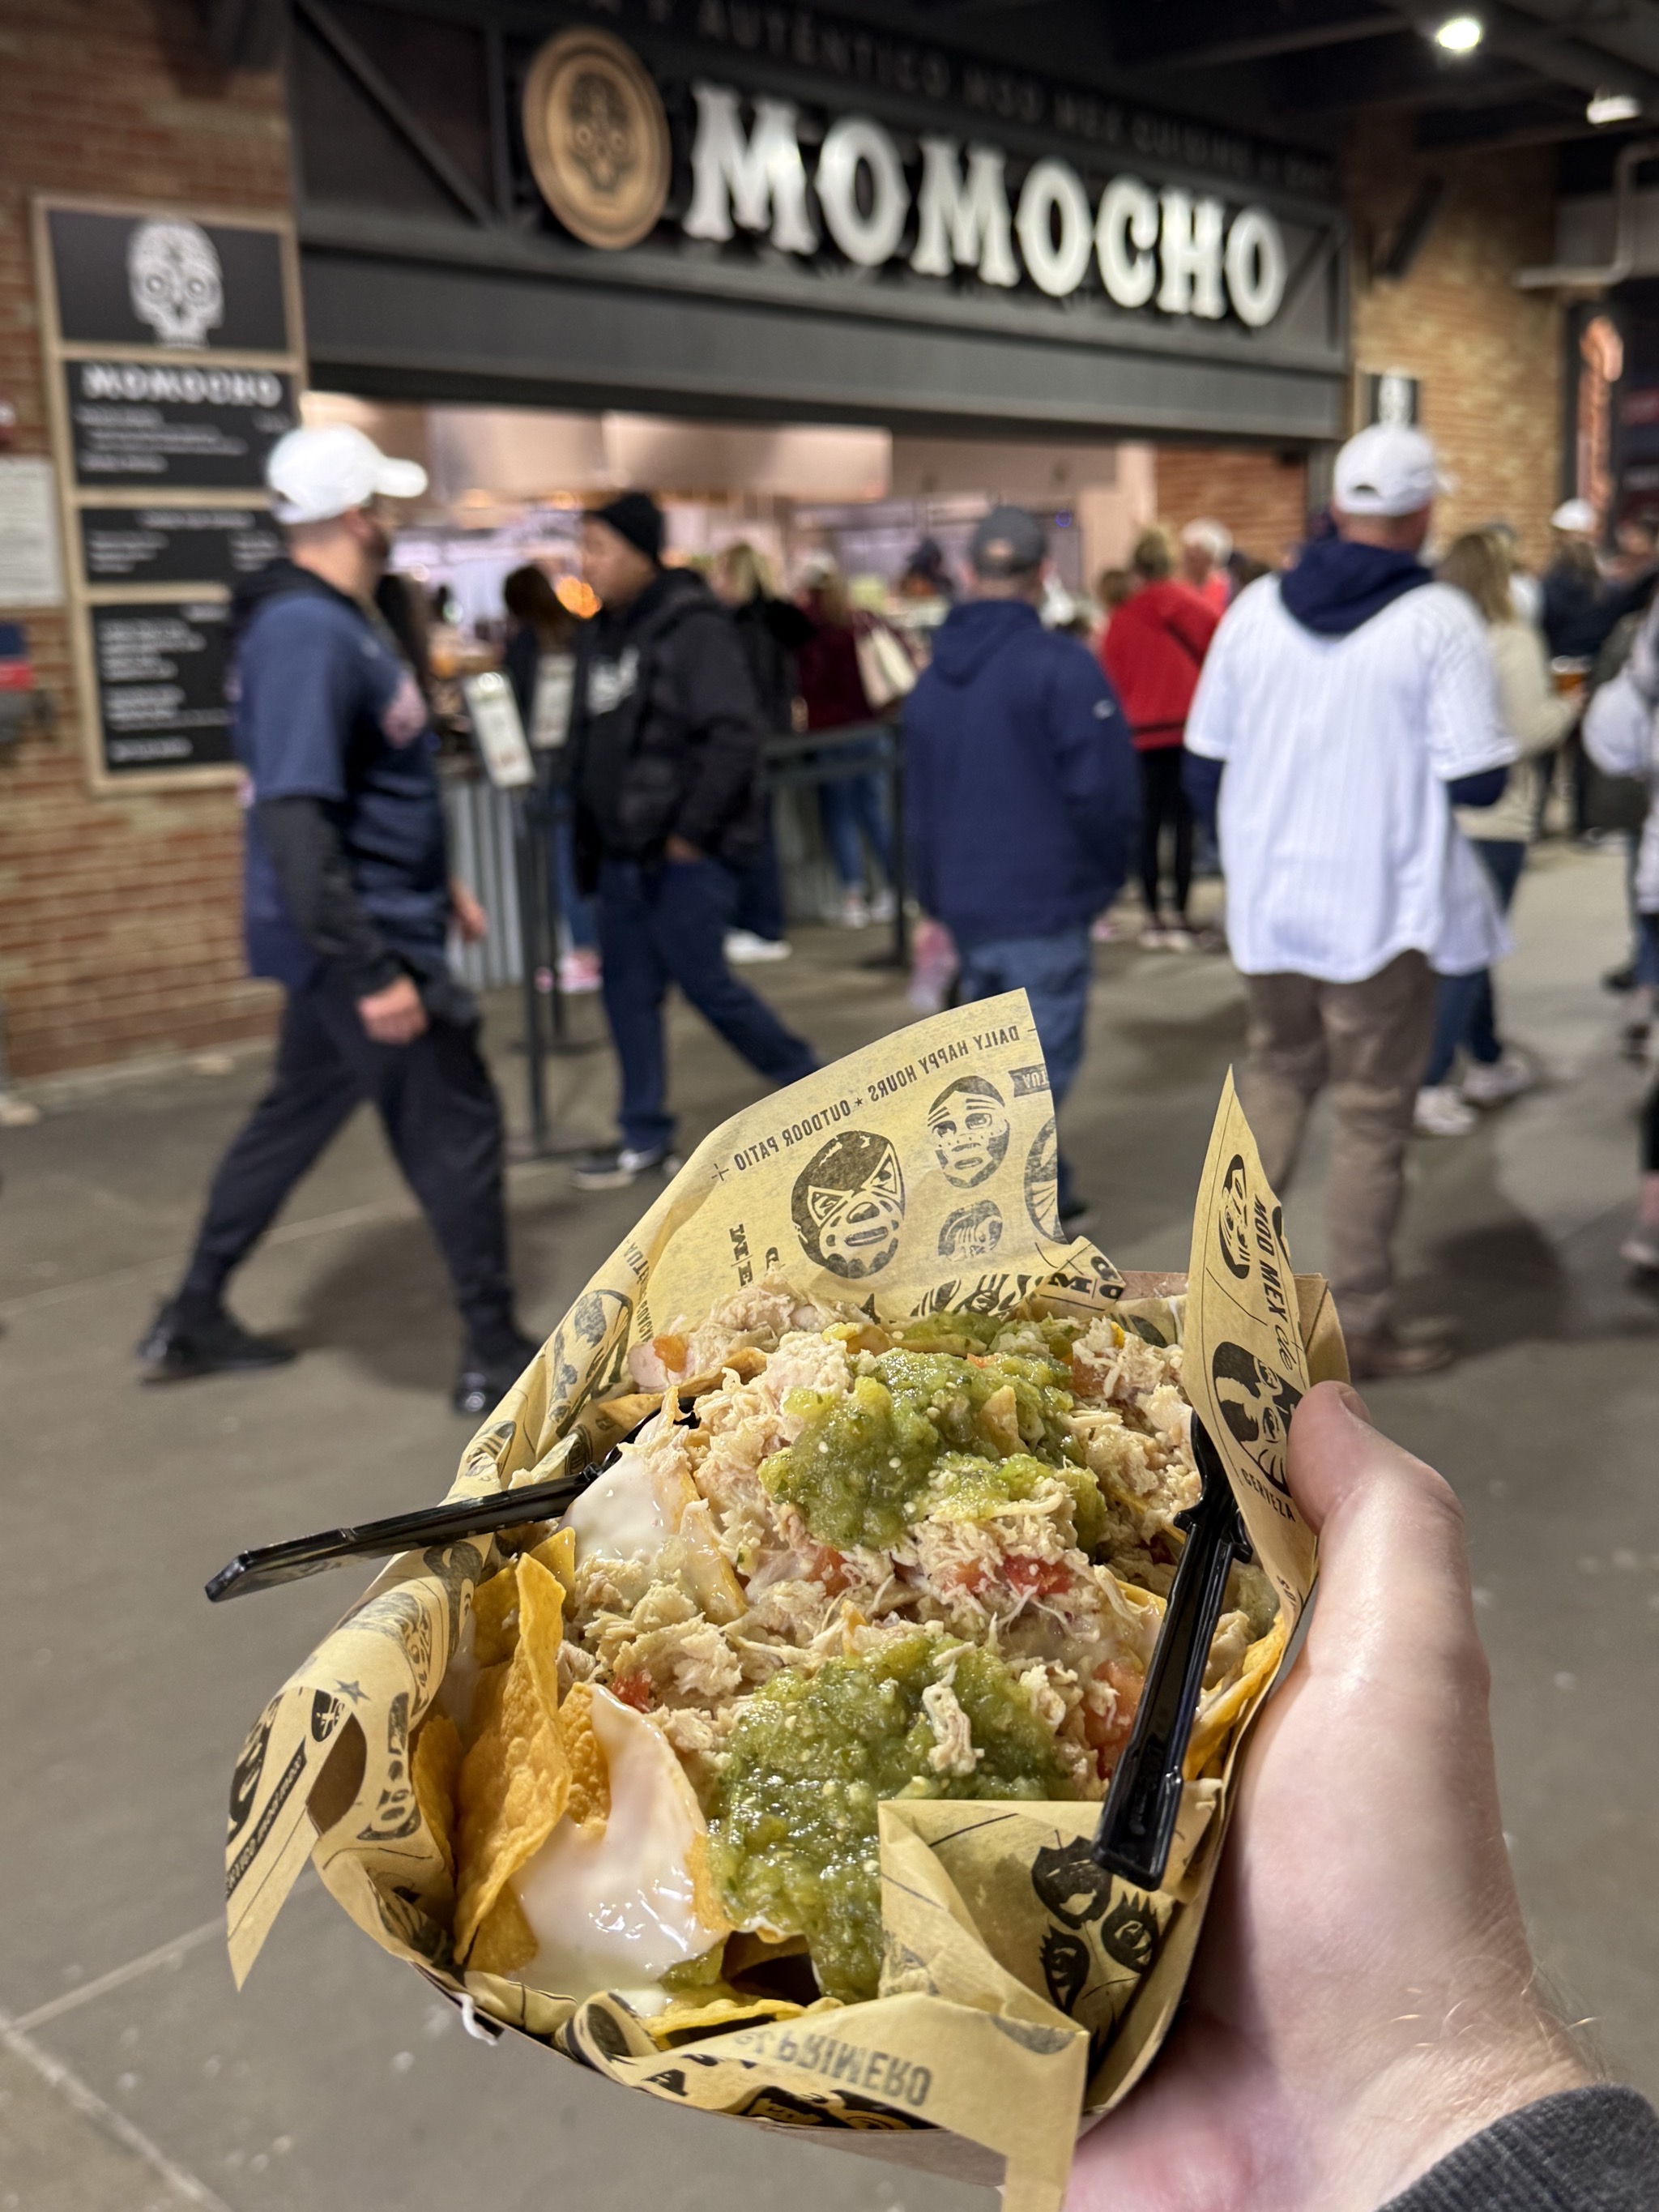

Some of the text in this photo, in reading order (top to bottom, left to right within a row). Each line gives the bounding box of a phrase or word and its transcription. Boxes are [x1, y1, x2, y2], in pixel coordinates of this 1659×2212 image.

[683, 81, 1288, 327] MOMOCHO
[1253, 1193, 1275, 1257] MOD
[1259, 1259, 1289, 1324] MEX
